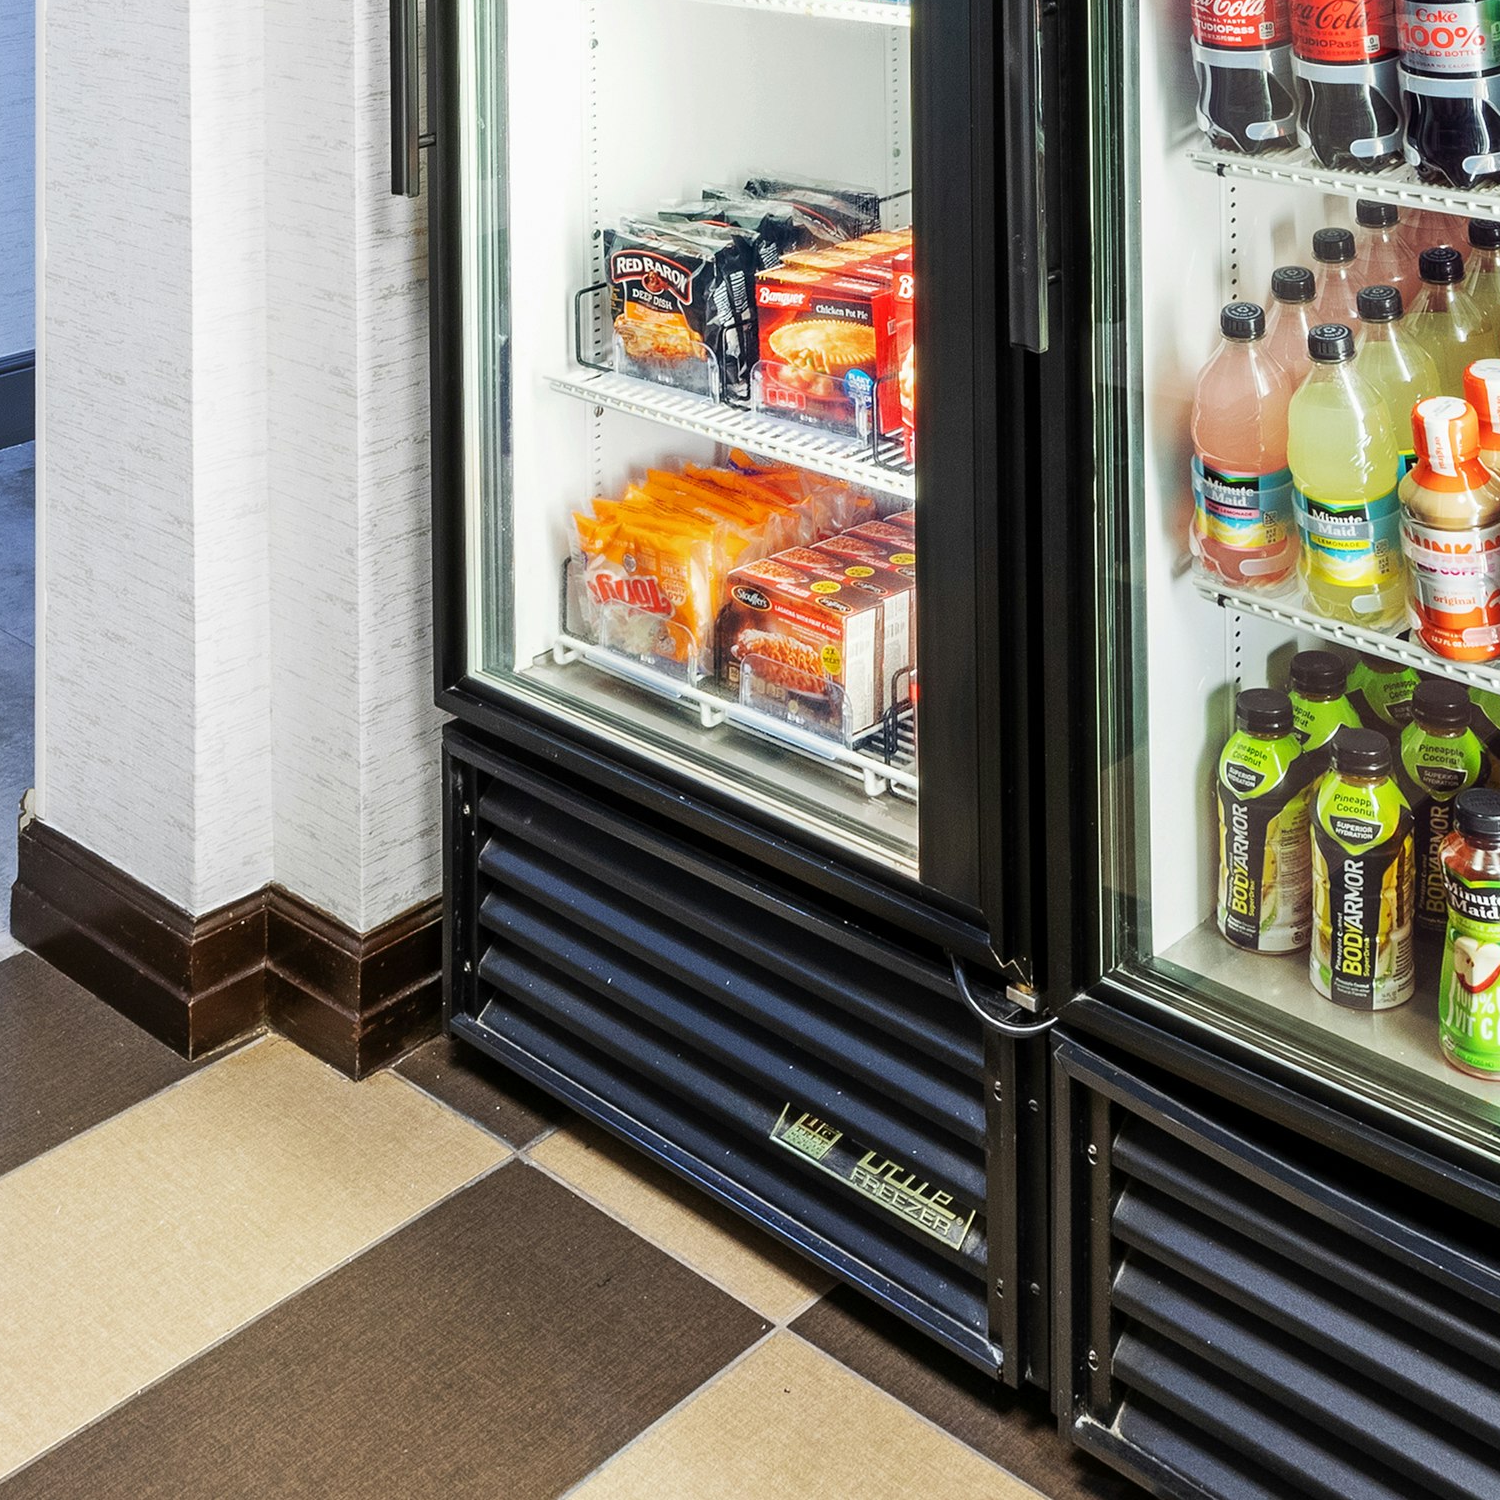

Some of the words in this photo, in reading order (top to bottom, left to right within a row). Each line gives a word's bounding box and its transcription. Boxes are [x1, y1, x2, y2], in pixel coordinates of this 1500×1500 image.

[1415, 8, 1458, 23] Coke
[1401, 22, 1486, 49] 100%
[616, 256, 643, 274] RED
[643, 256, 689, 293] BARON
[632, 289, 652, 302] DEEP
[653, 295, 673, 310] DISH
[759, 287, 806, 306] Banquet
[815, 304, 844, 317] Chicken
[845, 309, 856, 318] Pot
[857, 311, 868, 320] Pie
[1434, 436, 1447, 470] original
[1206, 476, 1254, 497] Minute
[1211, 490, 1247, 507] Maid
[1220, 507, 1252, 516] LEMONADE
[1312, 508, 1363, 524] Minute
[1318, 522, 1357, 537] Maid
[1317, 538, 1360, 548] LEMONADE
[736, 587, 768, 608] Stouffer's
[1433, 595, 1476, 606] original
[1234, 741, 1268, 761] Pineapple
[1419, 743, 1465, 759] Pineapple
[1422, 752, 1461, 766] Coconut
[1232, 751, 1262, 768] Coconut
[1228, 766, 1257, 782] SUPERIOR
[1333, 792, 1375, 808] Pineapp
[1336, 803, 1376, 818] Coconut
[1335, 827, 1374, 841] HYDRATION
[1336, 820, 1373, 834] SUPERIOR
[1232, 802, 1249, 915] BODYARMOR
[1342, 858, 1364, 977] BODYARMOR
[1455, 1004, 1476, 1037] VIT
[1480, 1017, 1494, 1040] C
[850, 1166, 952, 1236] FREEZER
